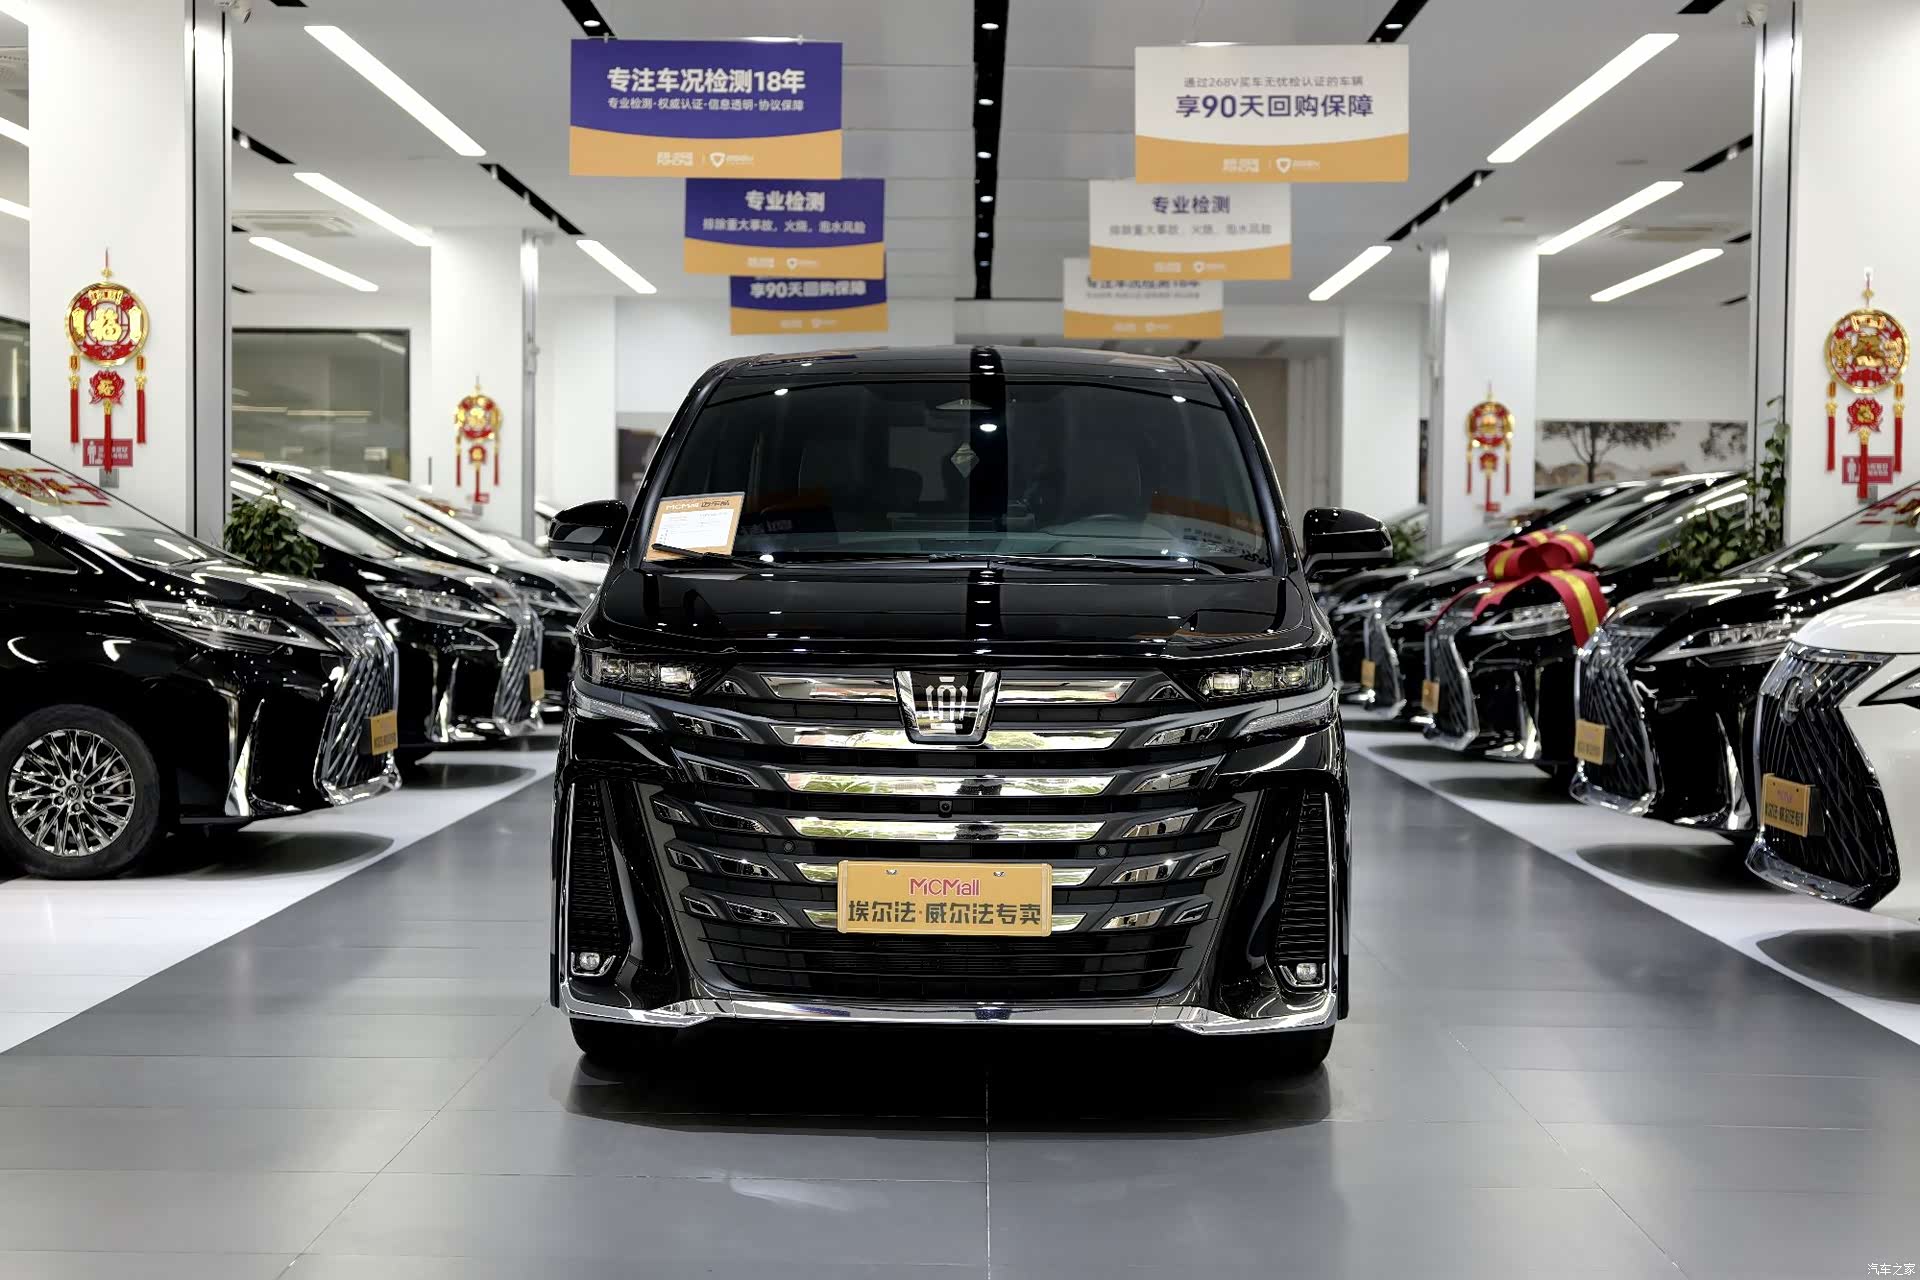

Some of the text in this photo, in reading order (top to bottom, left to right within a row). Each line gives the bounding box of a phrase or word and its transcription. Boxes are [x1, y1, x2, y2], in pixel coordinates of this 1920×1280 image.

[607, 67, 805, 94] 专注车况检测18年
[1184, 75, 1364, 88] 通过268V买车无忧检认证的车辆
[1176, 94, 1374, 118] 享90天回购保障
[745, 190, 826, 212] 专业检测
[1152, 195, 1231, 214] 专业检测
[909, 878, 981, 897] MCMall
[848, 900, 1041, 925] 埃尔法·威尔法专卖
